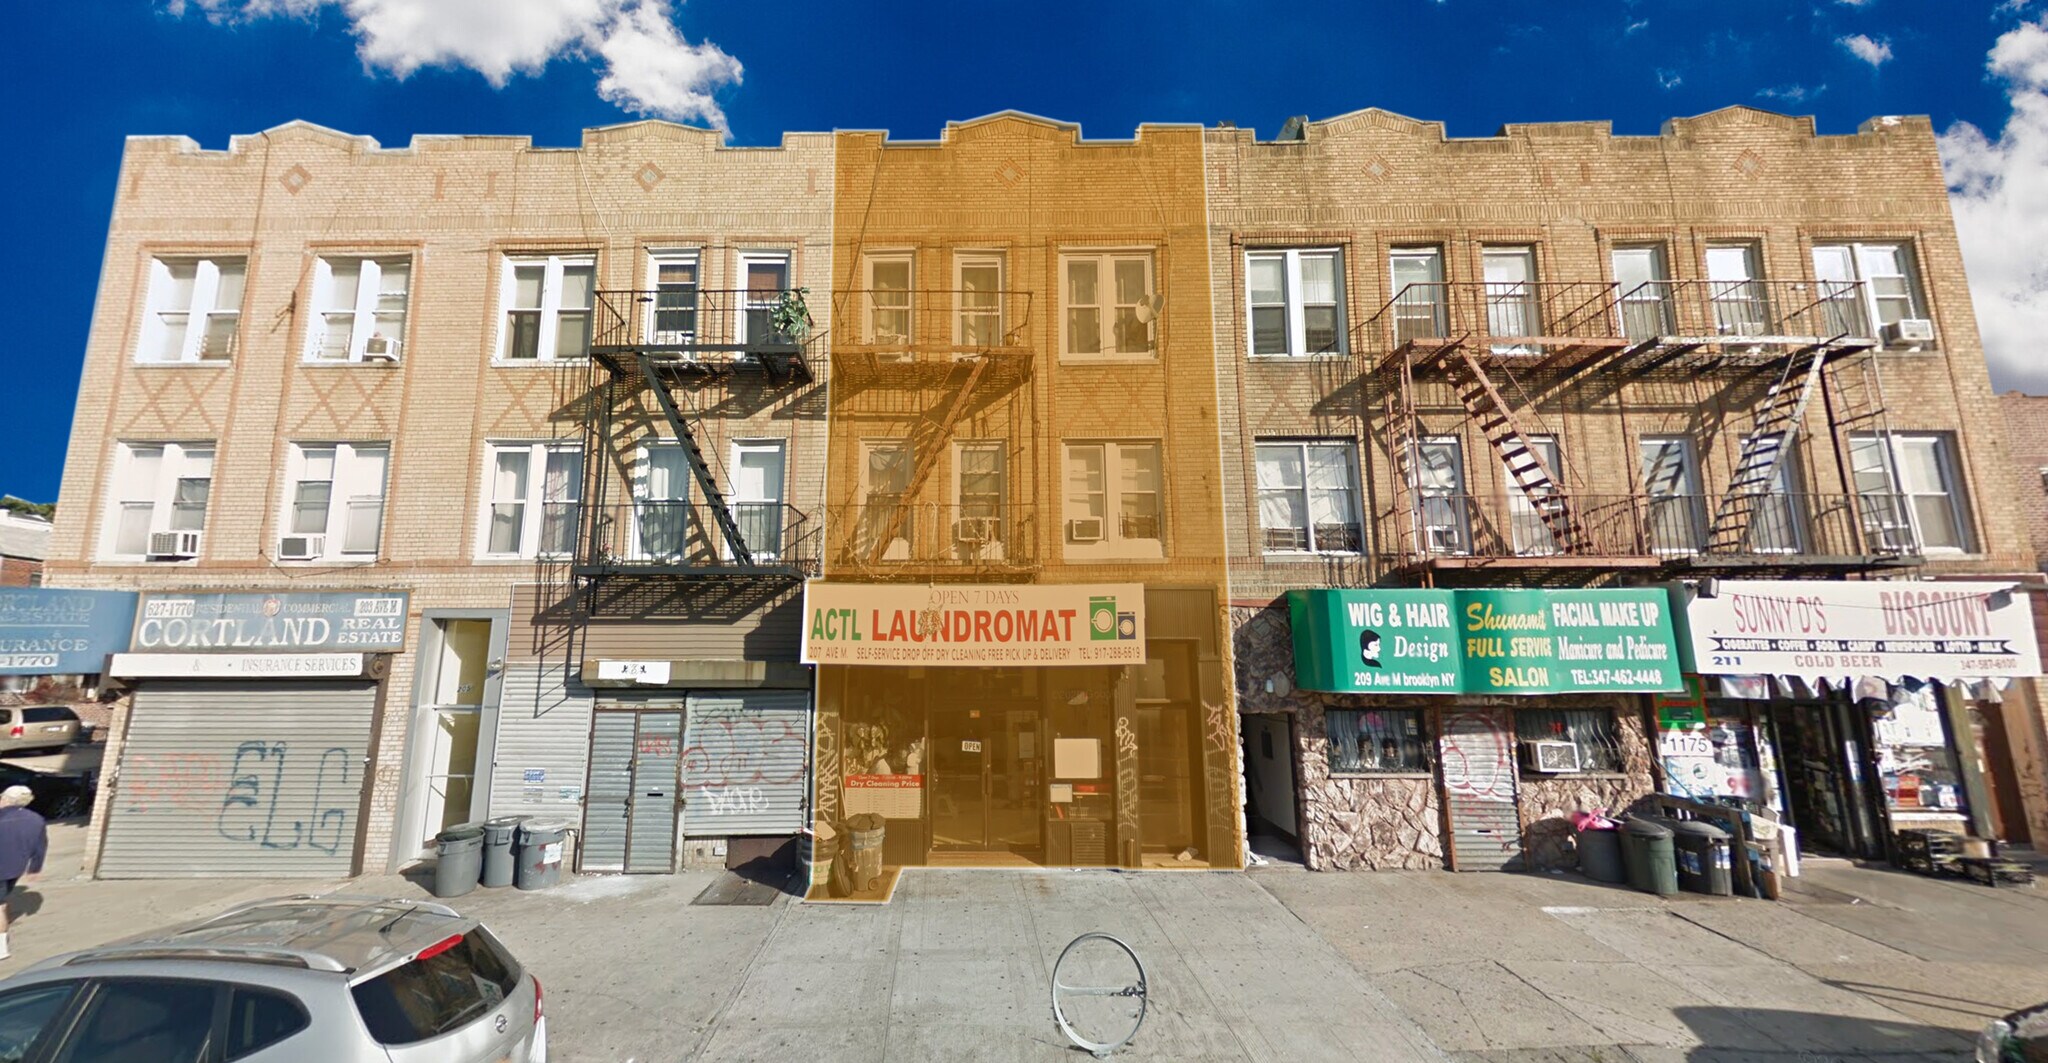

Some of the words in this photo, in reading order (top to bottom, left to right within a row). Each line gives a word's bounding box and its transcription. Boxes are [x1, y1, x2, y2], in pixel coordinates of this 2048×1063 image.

[930, 590, 969, 604] OPEN
[974, 590, 981, 604] 7
[985, 590, 1020, 604] DAYS
[341, 617, 401, 630] REAL
[1347, 603, 1384, 627] WIG
[1388, 603, 1402, 627] &
[1405, 603, 1450, 628] HAIR
[1552, 602, 1599, 627] FACIAL
[1599, 602, 1640, 627] MAKE
[1640, 602, 1659, 627] UP
[1733, 594, 1793, 633] SUNNY
[1796, 596, 1827, 634] D'S
[1879, 591, 1991, 636] DISCOUNT
[139, 618, 330, 647] CORTLAND
[811, 608, 862, 641] ACTL
[872, 608, 1077, 643] LAUNDROMAT
[337, 631, 402, 643] ESTATE
[809, 646, 822, 659] 207
[825, 647, 839, 659] AVE
[857, 647, 901, 660] SELF-SERVICE
[902, 648, 920, 660] DROP
[922, 648, 934, 660] OFF
[936, 648, 950, 660] DRY
[952, 648, 986, 660] CLEANING
[988, 648, 1004, 660] FREE
[1006, 648, 1021, 660] PICK
[1023, 648, 1032, 660] UP
[1040, 647, 1071, 660] DELIVERY
[1393, 635, 1449, 663] Design
[1467, 637, 1506, 658] FULL
[1557, 635, 1603, 660] Manicure
[1606, 635, 1625, 660] and
[1626, 635, 1668, 660] Pedicure
[241, 658, 302, 672] INSURANCE
[304, 658, 357, 672] SERVICES
[1712, 655, 1742, 666] 211
[1794, 655, 1835, 668] COLD
[1840, 655, 1883, 668] BEER
[1354, 672, 1372, 686] 209
[1374, 672, 1390, 686] Ave
[1392, 672, 1401, 686] M
[1441, 672, 1456, 687] NY
[1489, 667, 1550, 687] SALON
[964, 742, 980, 751] OPEN
